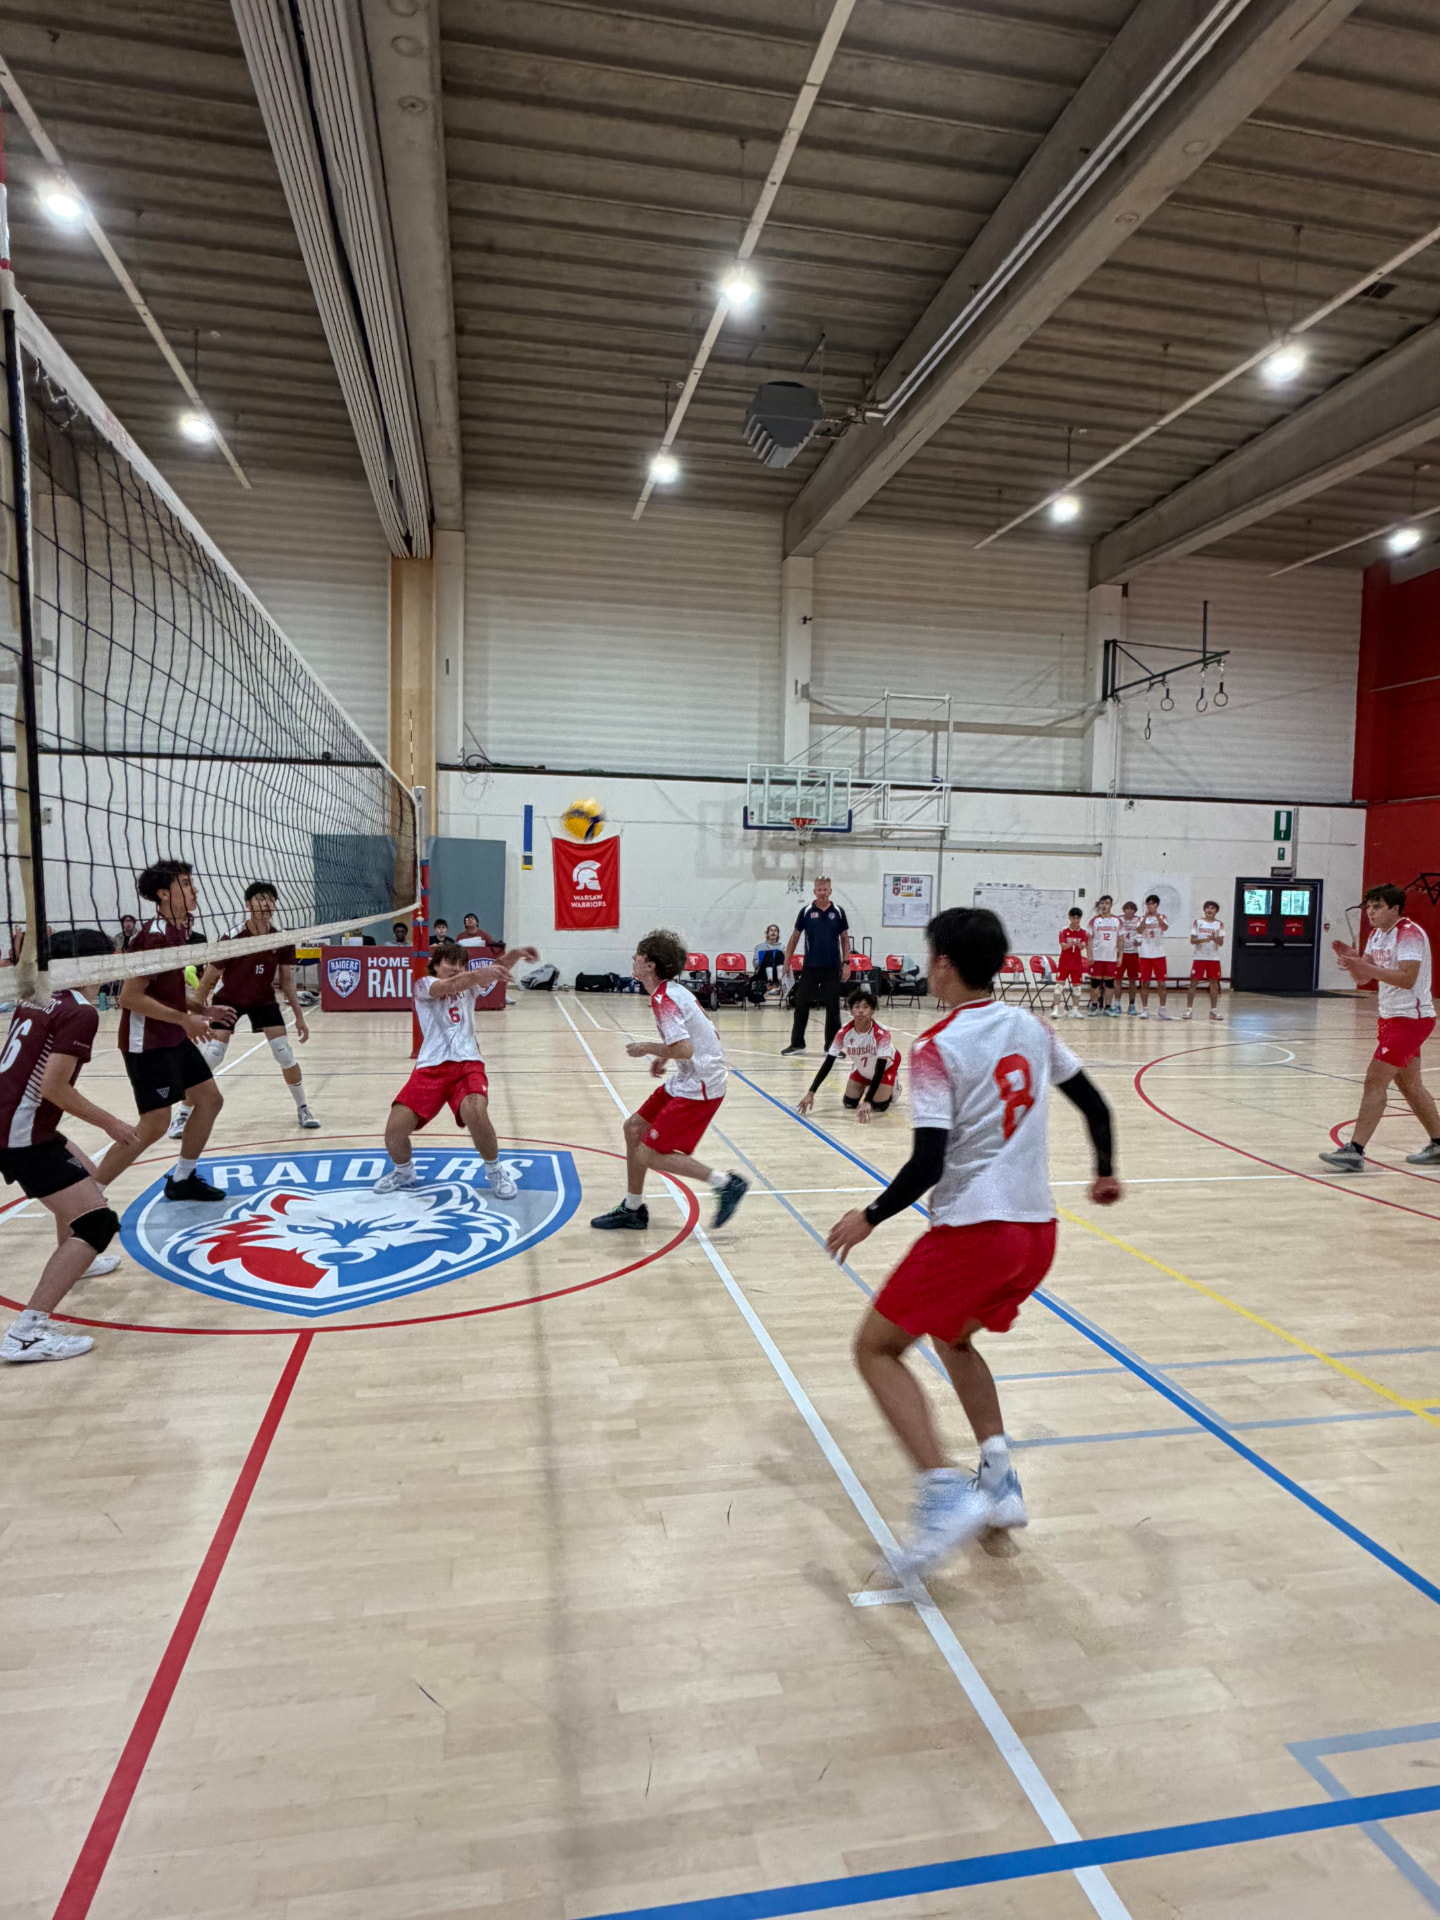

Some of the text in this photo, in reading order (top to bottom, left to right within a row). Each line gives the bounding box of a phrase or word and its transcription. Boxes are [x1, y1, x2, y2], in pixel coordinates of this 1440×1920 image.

[570, 900, 606, 908] WARRIORS
[1102, 933, 1111, 941] 12
[330, 960, 359, 970] RAIDERS
[367, 957, 410, 967] HOME
[255, 964, 265, 975] 15
[448, 1007, 461, 1024] 6
